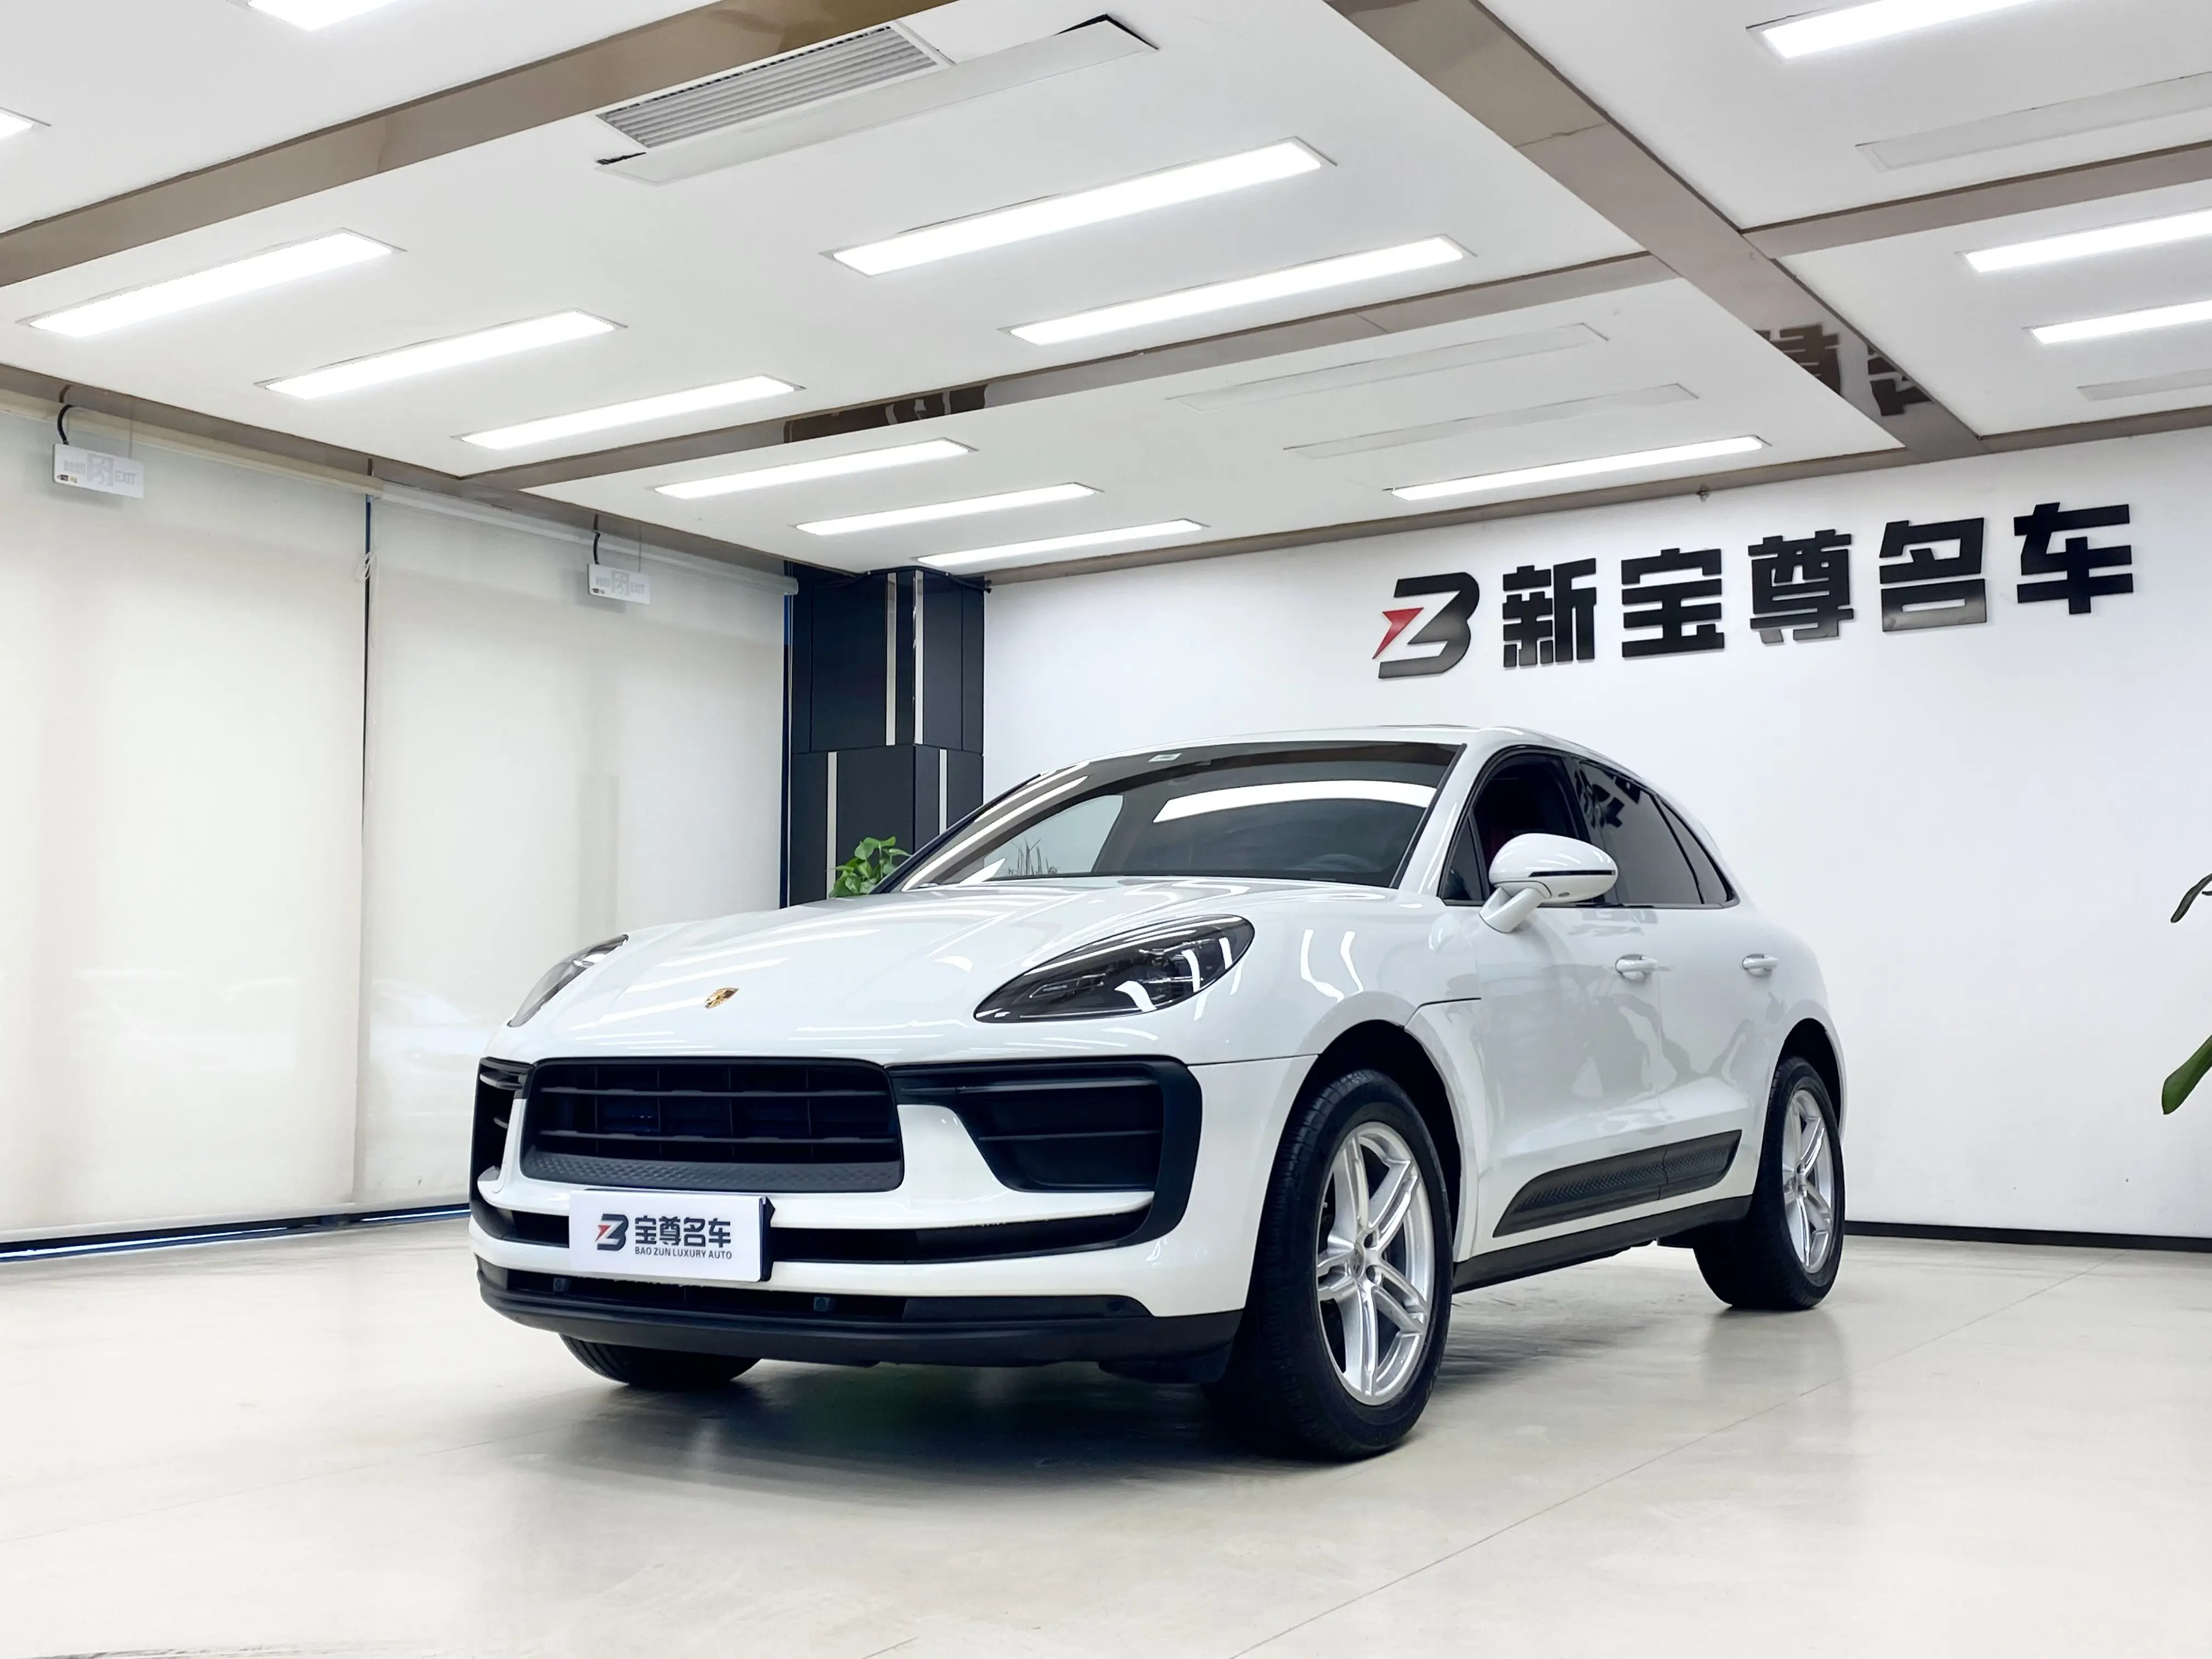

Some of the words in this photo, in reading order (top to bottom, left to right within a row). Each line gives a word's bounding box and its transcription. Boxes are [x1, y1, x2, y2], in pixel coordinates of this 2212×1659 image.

[1502, 502, 2134, 668] 新宝尊名车
[635, 1215, 731, 1248] 宝尊名车
[635, 1246, 652, 1255] BAO
[653, 1248, 671, 1256] ZUN
[673, 1249, 707, 1258] LUXURY
[708, 1251, 732, 1260] AUTO
